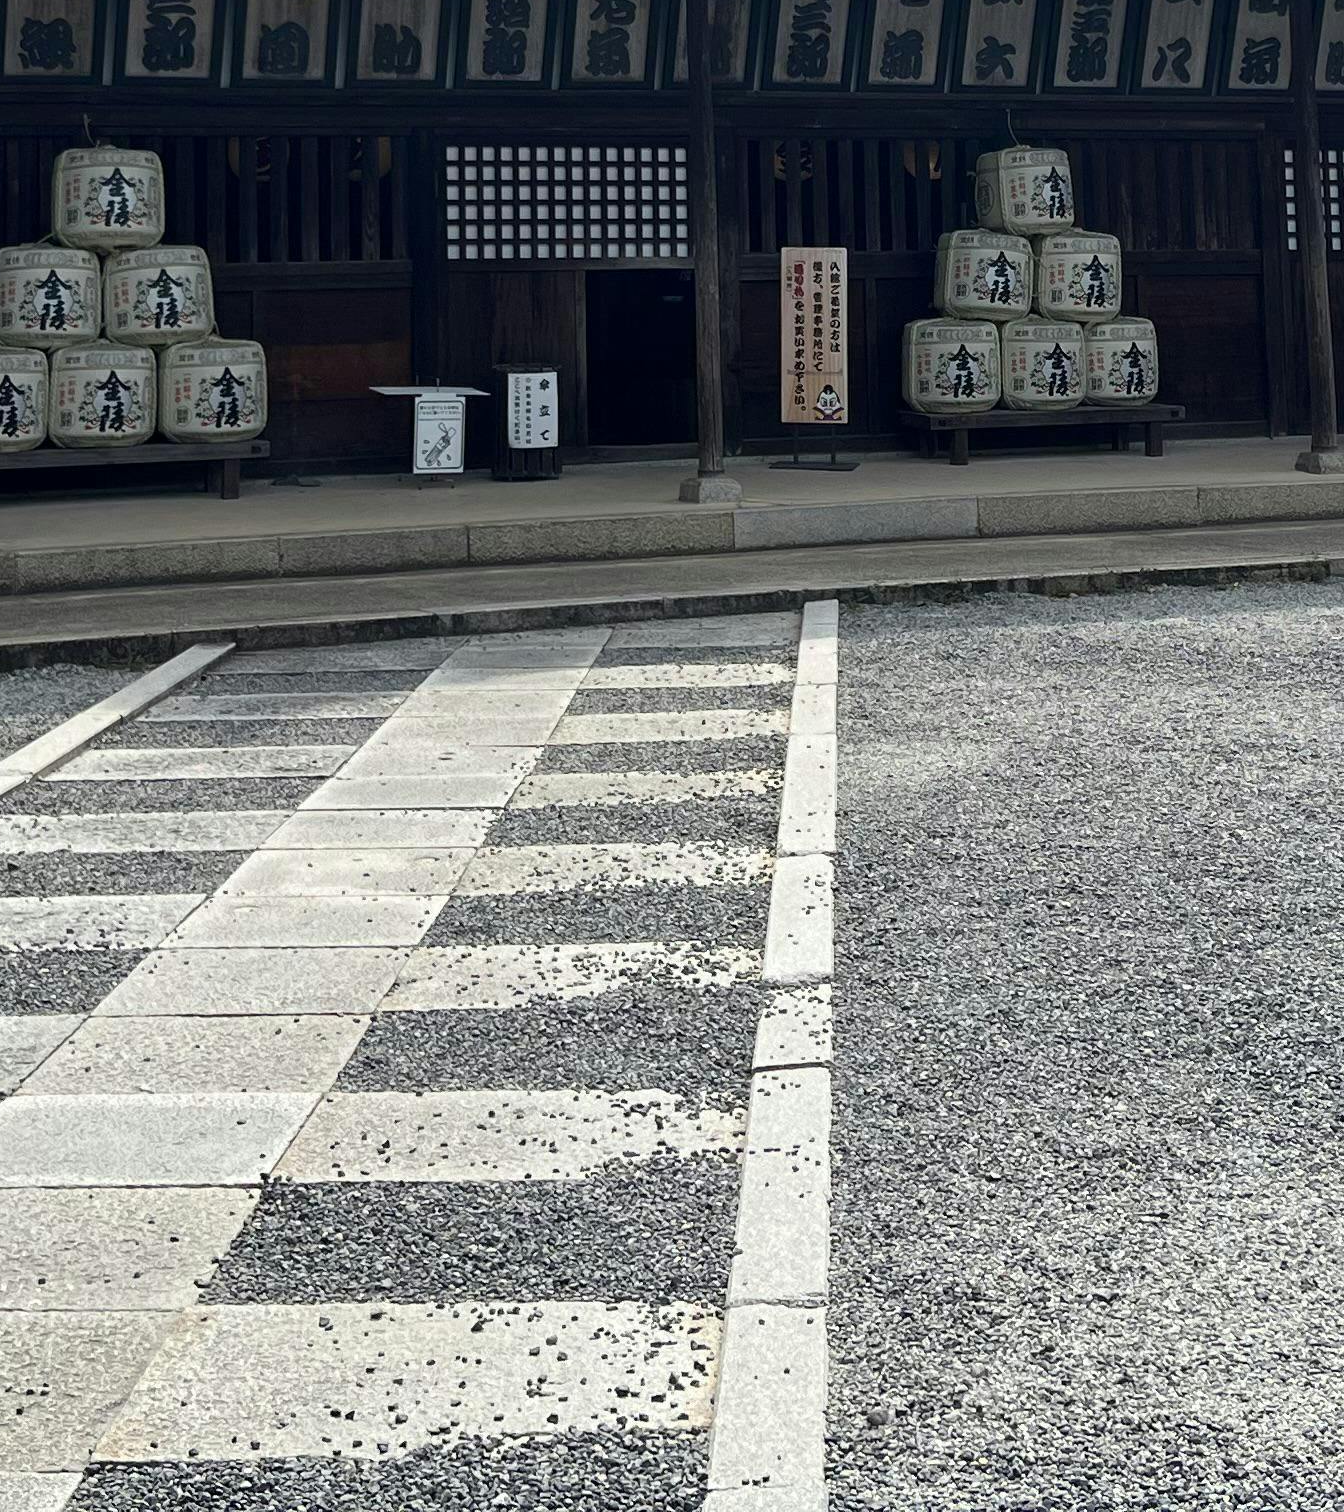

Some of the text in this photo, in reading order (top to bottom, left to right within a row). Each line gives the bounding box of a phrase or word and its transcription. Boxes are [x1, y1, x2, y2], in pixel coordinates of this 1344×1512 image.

[99, 167, 136, 228] 金陵
[1042, 166, 1067, 219] 金陵
[35, 269, 73, 331] 金陵
[145, 268, 183, 329] 金陵
[987, 251, 1017, 306] 金陵
[1081, 255, 1110, 308] 金陵
[948, 343, 980, 399] 金陵
[1043, 342, 1072, 397] 金陵
[1120, 342, 1148, 395] 金陵
[95, 370, 132, 433] 金陵
[210, 366, 245, 429] 金陵
